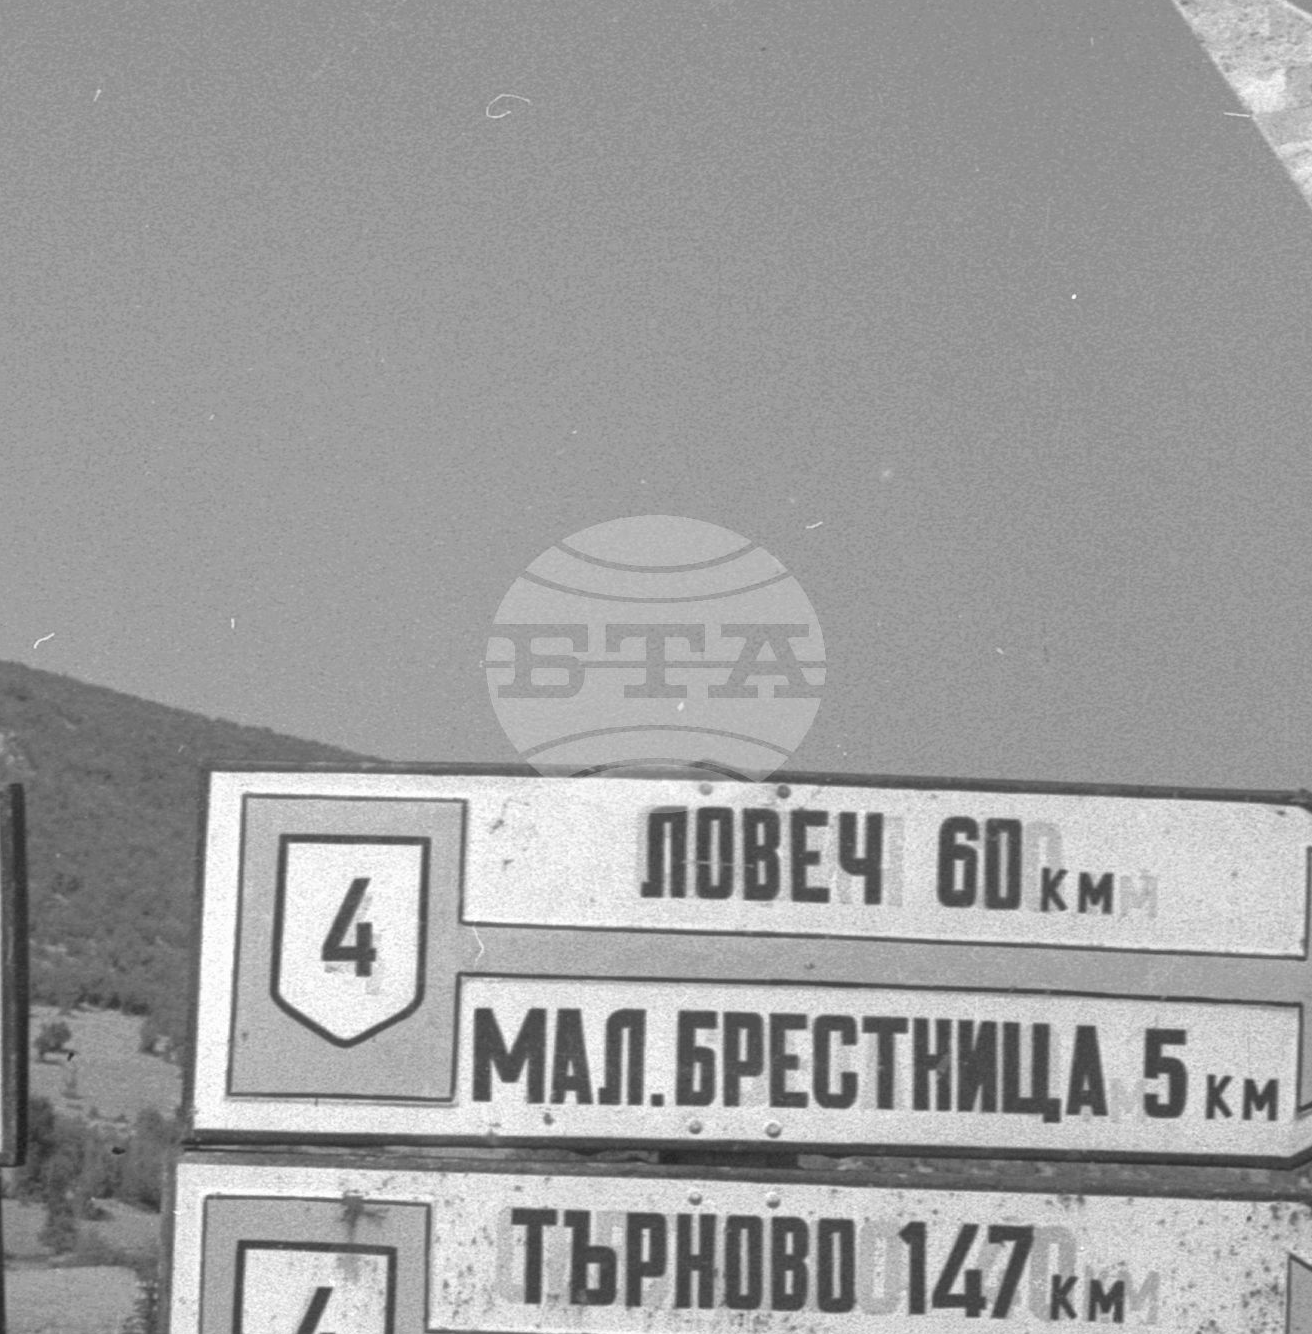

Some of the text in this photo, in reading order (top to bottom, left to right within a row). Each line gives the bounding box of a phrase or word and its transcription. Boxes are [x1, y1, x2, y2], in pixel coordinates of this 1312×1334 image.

[641, 807, 883, 904] ЛОВЕЧ
[937, 817, 1022, 910] 60
[322, 879, 376, 976] 4
[1144, 1028, 1187, 1118] 5
[511, 1208, 856, 1313] ТЪРНОВО
[898, 1221, 1035, 1319] 147
